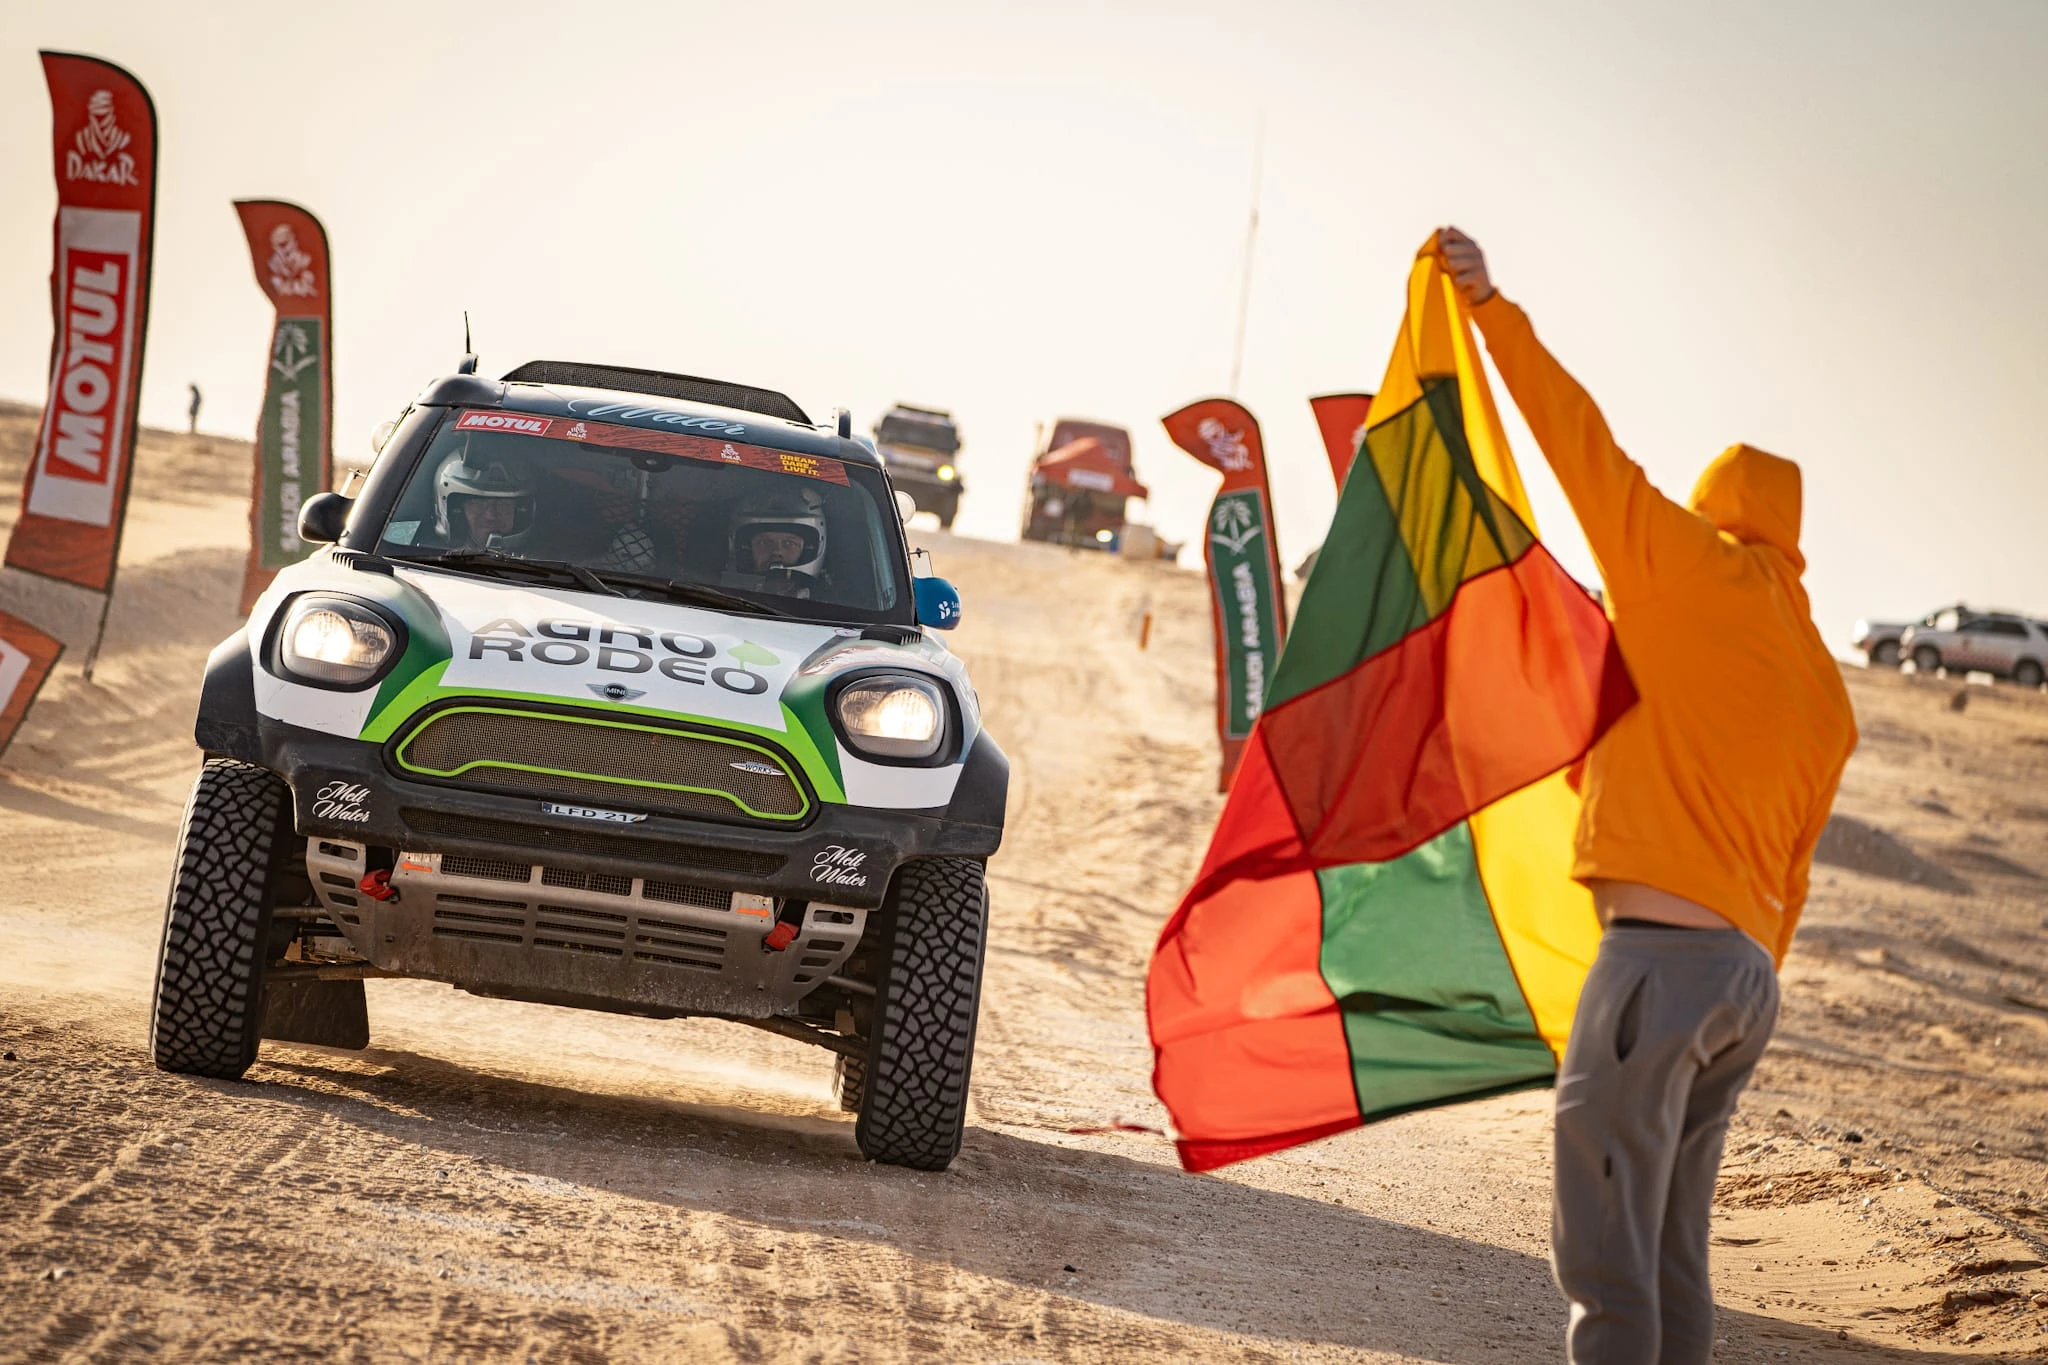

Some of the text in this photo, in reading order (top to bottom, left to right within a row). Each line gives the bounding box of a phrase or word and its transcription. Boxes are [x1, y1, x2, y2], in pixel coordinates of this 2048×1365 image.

[66, 150, 139, 187] DAKAR
[55, 261, 121, 475] MOTUL
[279, 388, 300, 479] ARABIA
[463, 414, 543, 432] MOTUL
[780, 454, 819, 466] DREAM.
[781, 460, 812, 470] DARE.
[784, 465, 820, 476] LIVE IT.
[1232, 561, 1260, 648] ARABIA
[471, 617, 717, 659] AGRO
[468, 635, 769, 695] RODEO
[606, 687, 627, 696] MINI
[316, 780, 371, 803] Melt
[312, 800, 371, 823] Water
[555, 806, 597, 818] LFD
[813, 844, 867, 867] Melt
[809, 864, 867, 887] Water
